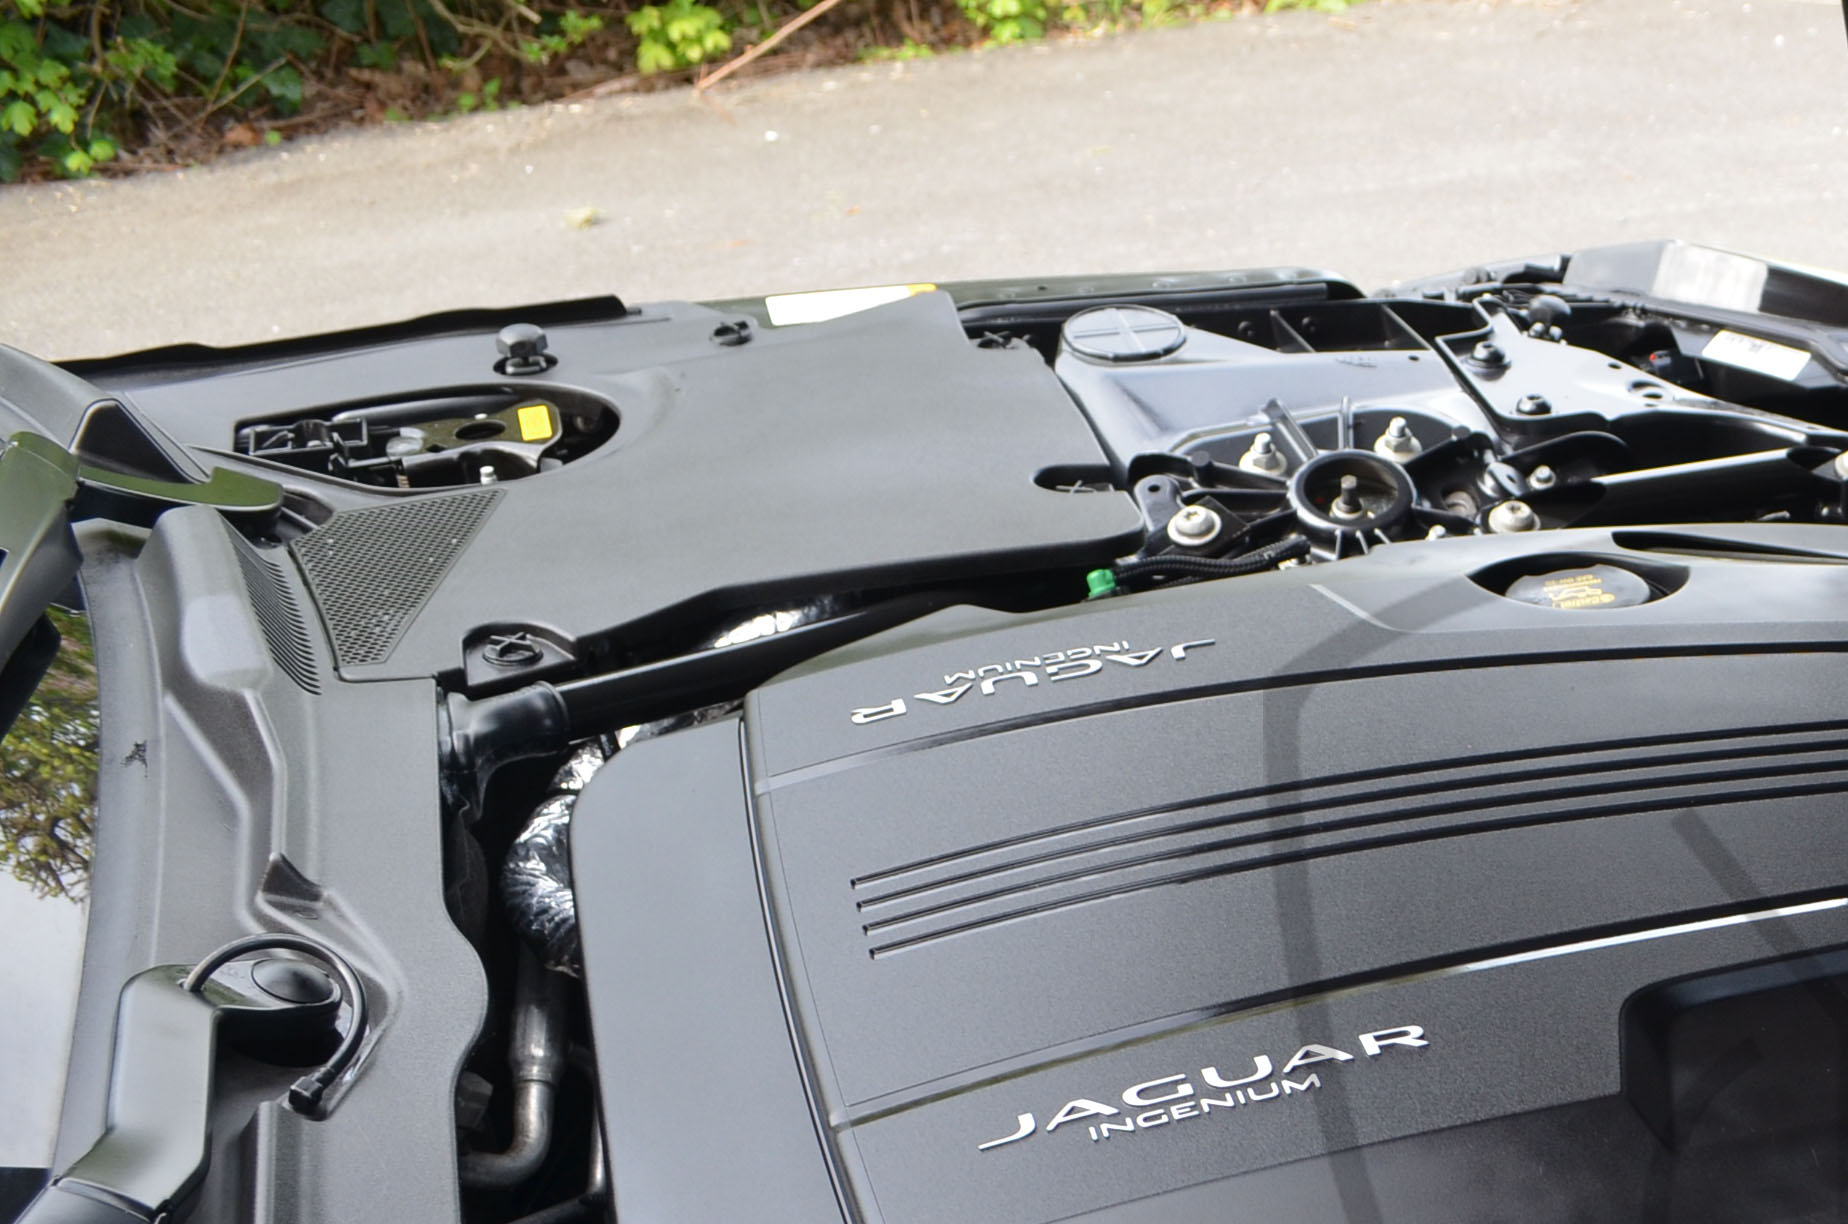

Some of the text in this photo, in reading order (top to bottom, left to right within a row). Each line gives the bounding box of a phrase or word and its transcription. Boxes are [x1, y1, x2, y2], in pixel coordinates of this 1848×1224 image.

[851, 638, 1215, 724] JAGUAR
[943, 640, 1130, 684] INGENIUM
[978, 1024, 1430, 1151] JAGUAR
[1088, 1073, 1323, 1142] INGENIUM
